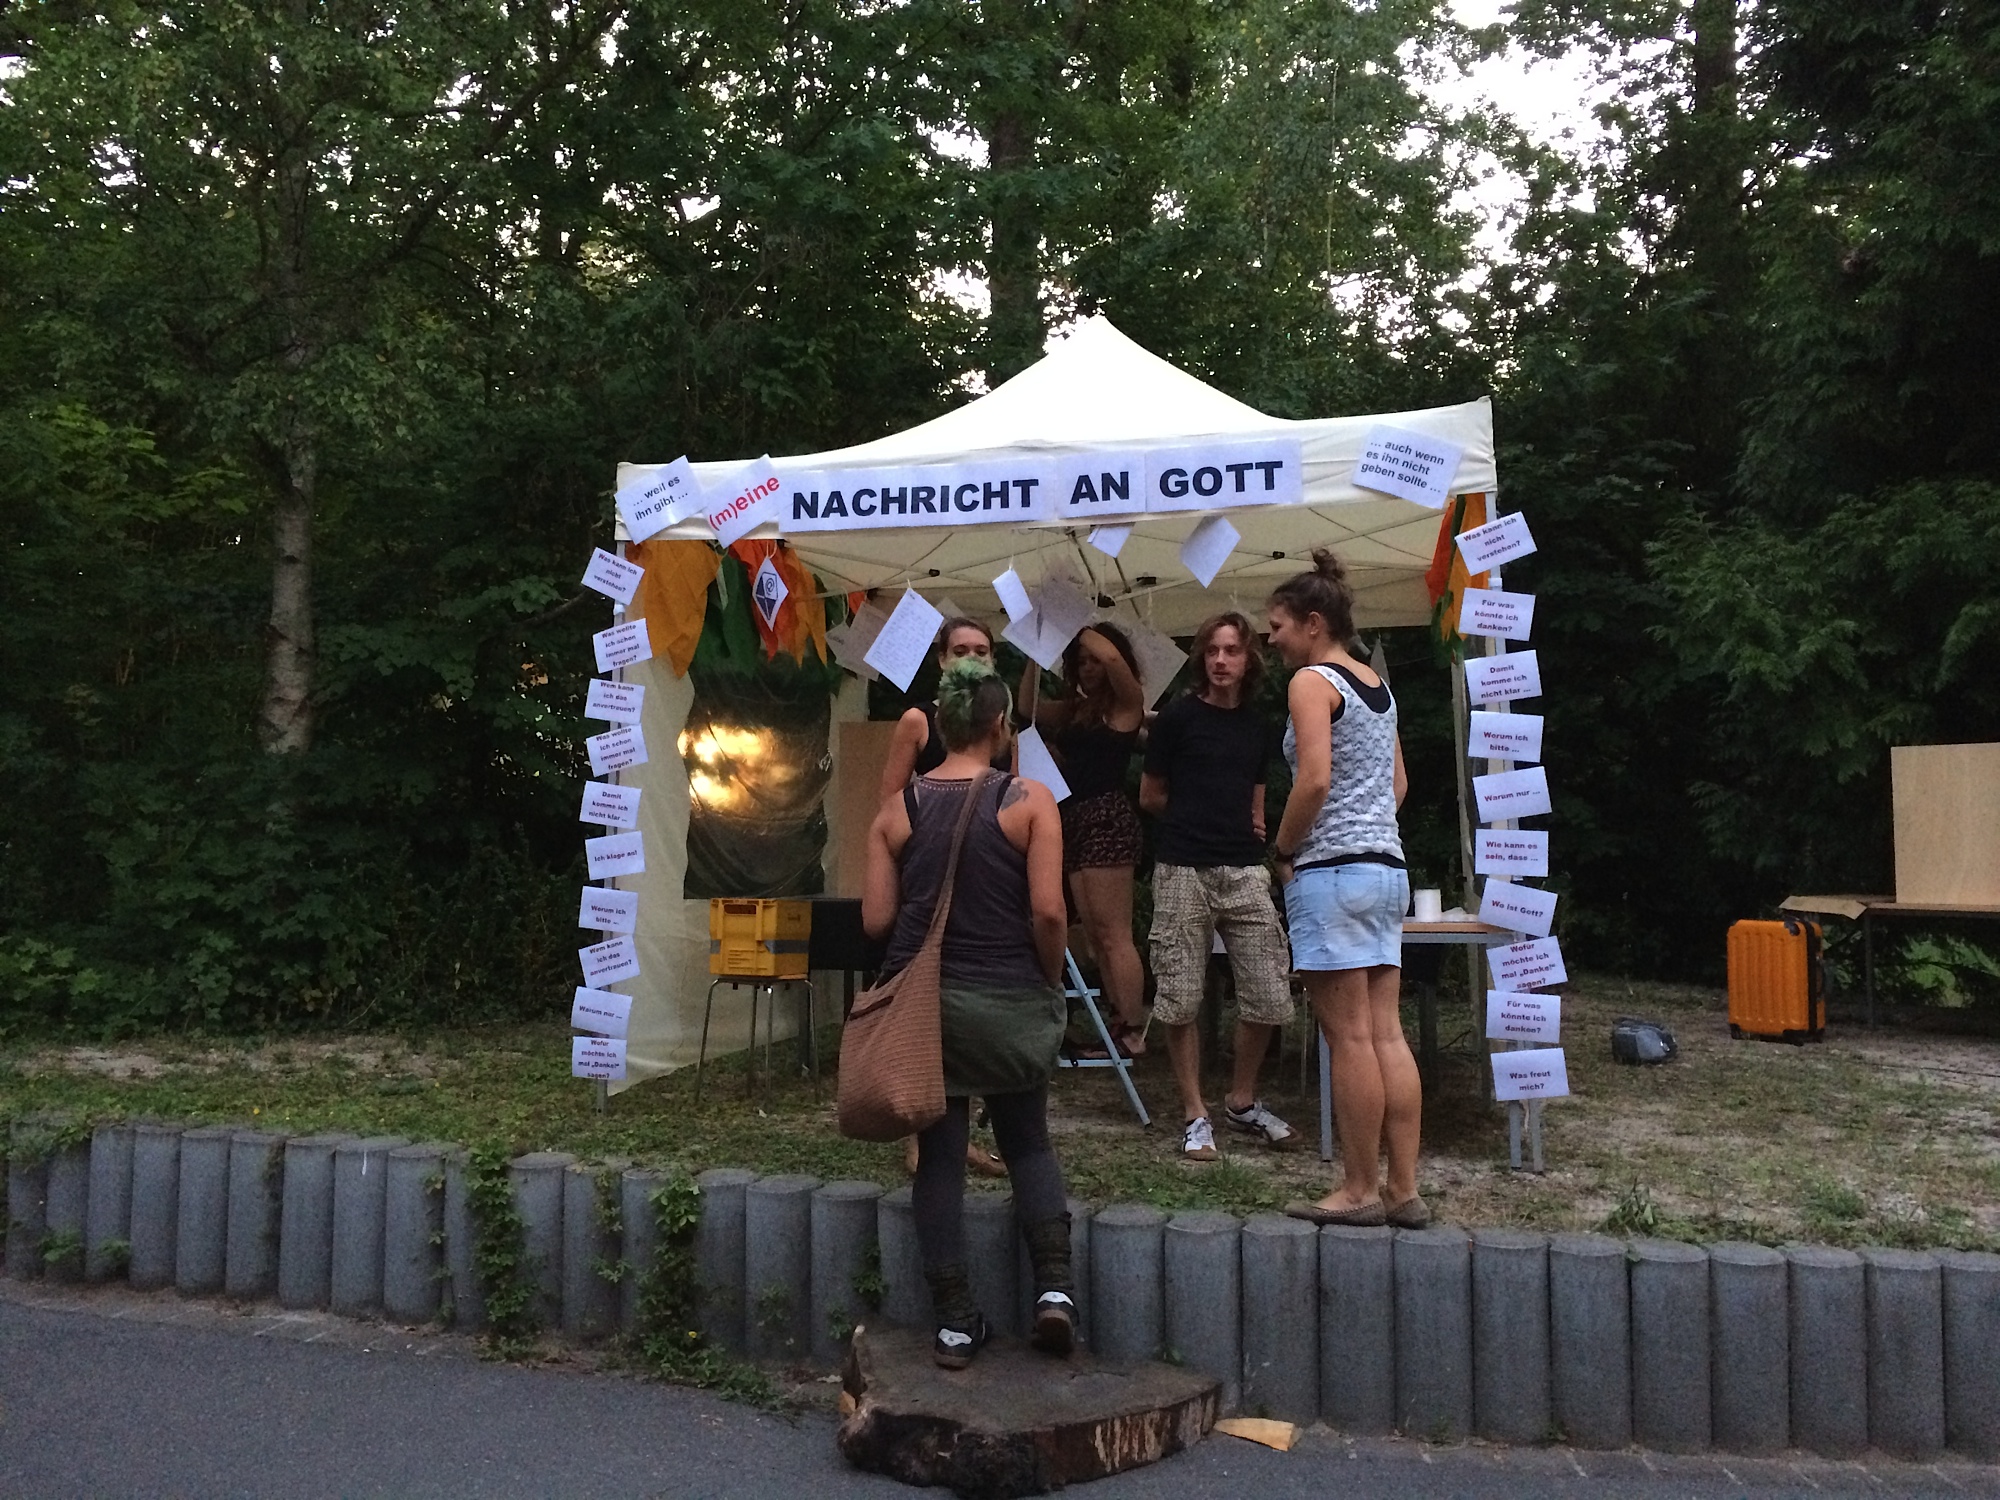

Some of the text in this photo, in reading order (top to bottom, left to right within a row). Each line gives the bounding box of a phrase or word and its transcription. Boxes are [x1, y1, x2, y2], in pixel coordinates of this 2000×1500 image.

[1385, 441, 1412, 455] auch
[1415, 451, 1444, 465] wenn
[1366, 451, 1430, 475] es ihn nicht
[1361, 463, 1395, 477] geben
[1397, 473, 1427, 488] sollte
[644, 483, 665, 499] weil
[668, 476, 680, 487] es
[709, 460, 1284, 531] (m)eine NACHRICHT AN GOTT
[635, 508, 652, 520] ihn
[655, 496, 674, 512] gibt
[1463, 517, 1516, 542] Was kann ich
[1485, 535, 1505, 546] nicht
[1477, 540, 1521, 562] verstehen?
[599, 553, 637, 575] Was kann ich
[606, 569, 621, 579] nicht
[594, 575, 626, 592] verstehen?
[602, 624, 636, 639] Was wollte
[1477, 622, 1512, 632] danken?
[606, 643, 639, 658] immer mal
[613, 655, 637, 667] fragen?
[1490, 665, 1514, 673] Damit
[1481, 677, 1511, 686] komme
[1481, 690, 1502, 698] nicht
[612, 728, 631, 737] wollte
[1484, 732, 1512, 740] Worum
[612, 738, 631, 747] schon
[601, 752, 621, 761] immer
[608, 759, 632, 770] fragen?
[1485, 792, 1514, 802] Warum
[592, 801, 616, 809] komme
[1492, 900, 1504, 908] Wo
[1520, 907, 1543, 917] Gott?
[590, 941, 623, 954] Wem kann
[1502, 956, 1533, 966] möchte
[590, 959, 631, 976] anvertrauen?
[1517, 978, 1546, 989] sagen?
[579, 1006, 602, 1015] Warum
[1505, 1025, 1541, 1033] danken?
[1519, 1083, 1544, 1091] mich?
